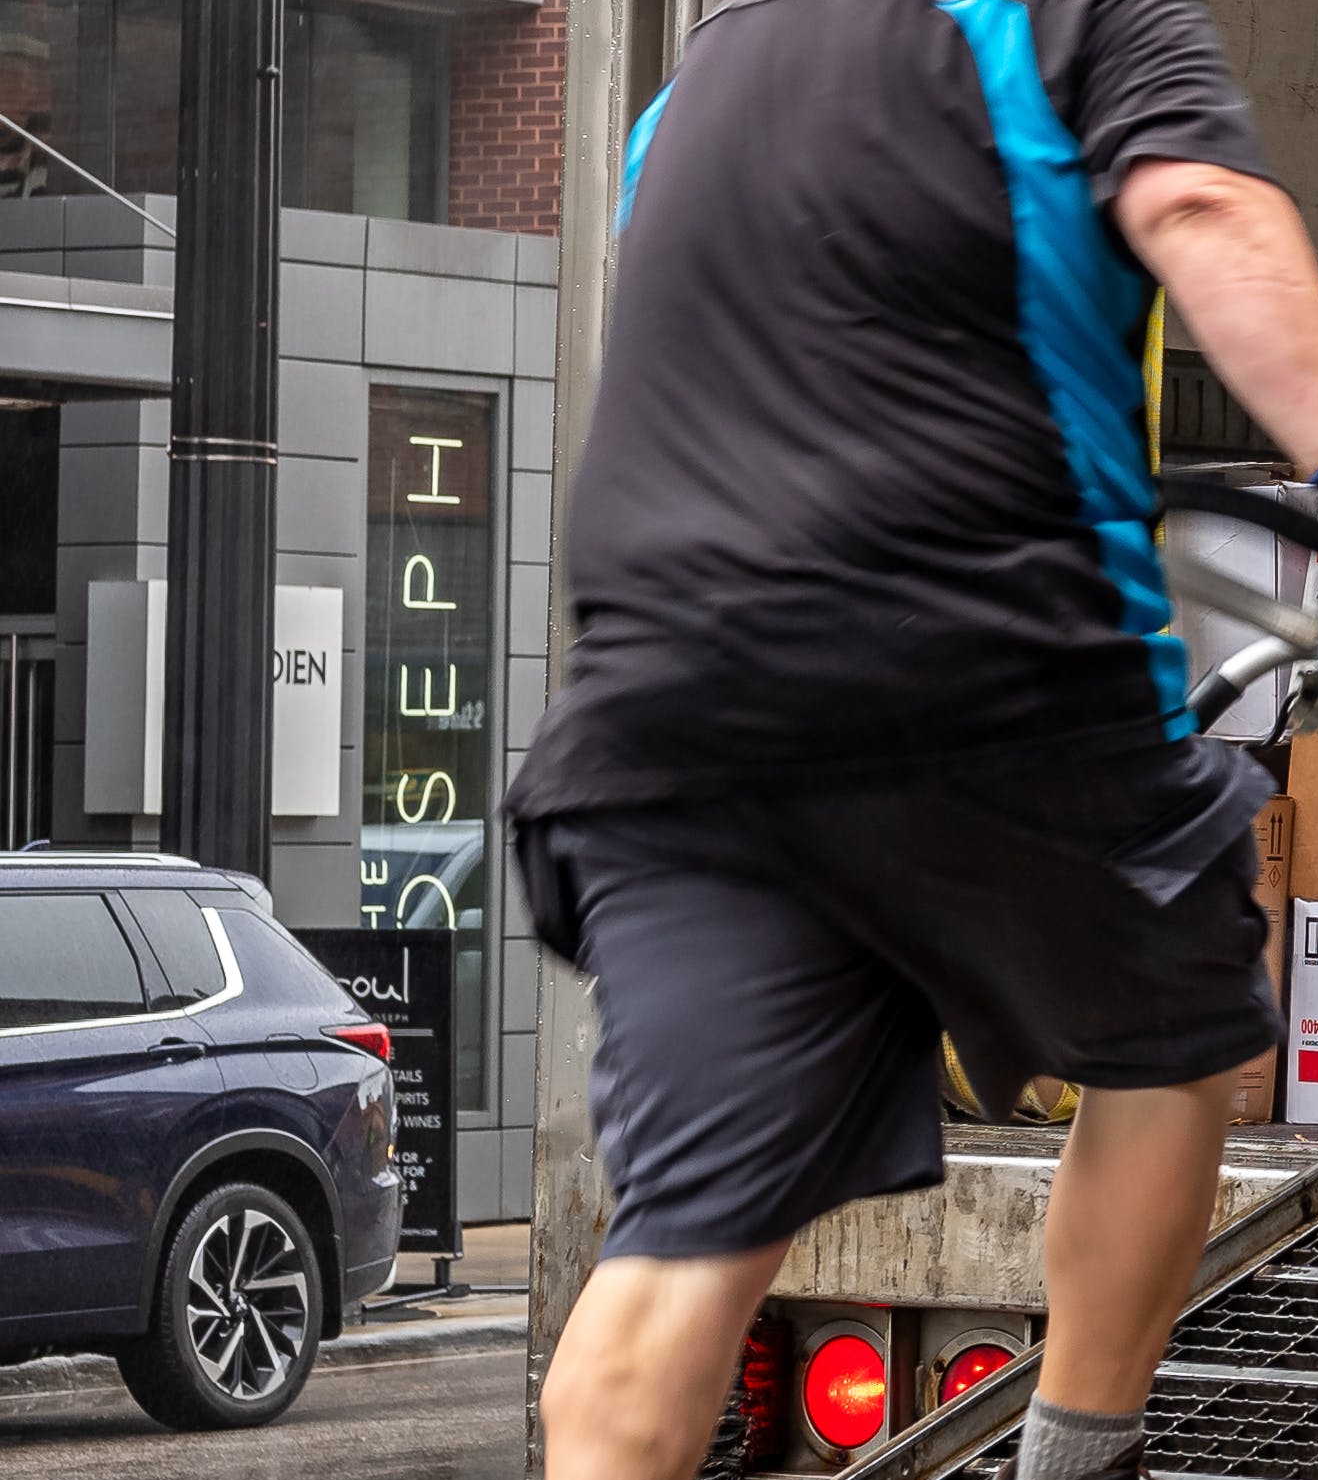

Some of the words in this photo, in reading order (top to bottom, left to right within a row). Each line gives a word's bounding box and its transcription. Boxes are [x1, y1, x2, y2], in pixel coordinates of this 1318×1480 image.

[336, 947, 409, 1004] oul
[404, 1115, 441, 1129] WINES
[402, 1153, 418, 1164] OR
[402, 1167, 425, 1178] FOR
[409, 1183, 417, 1192] &
